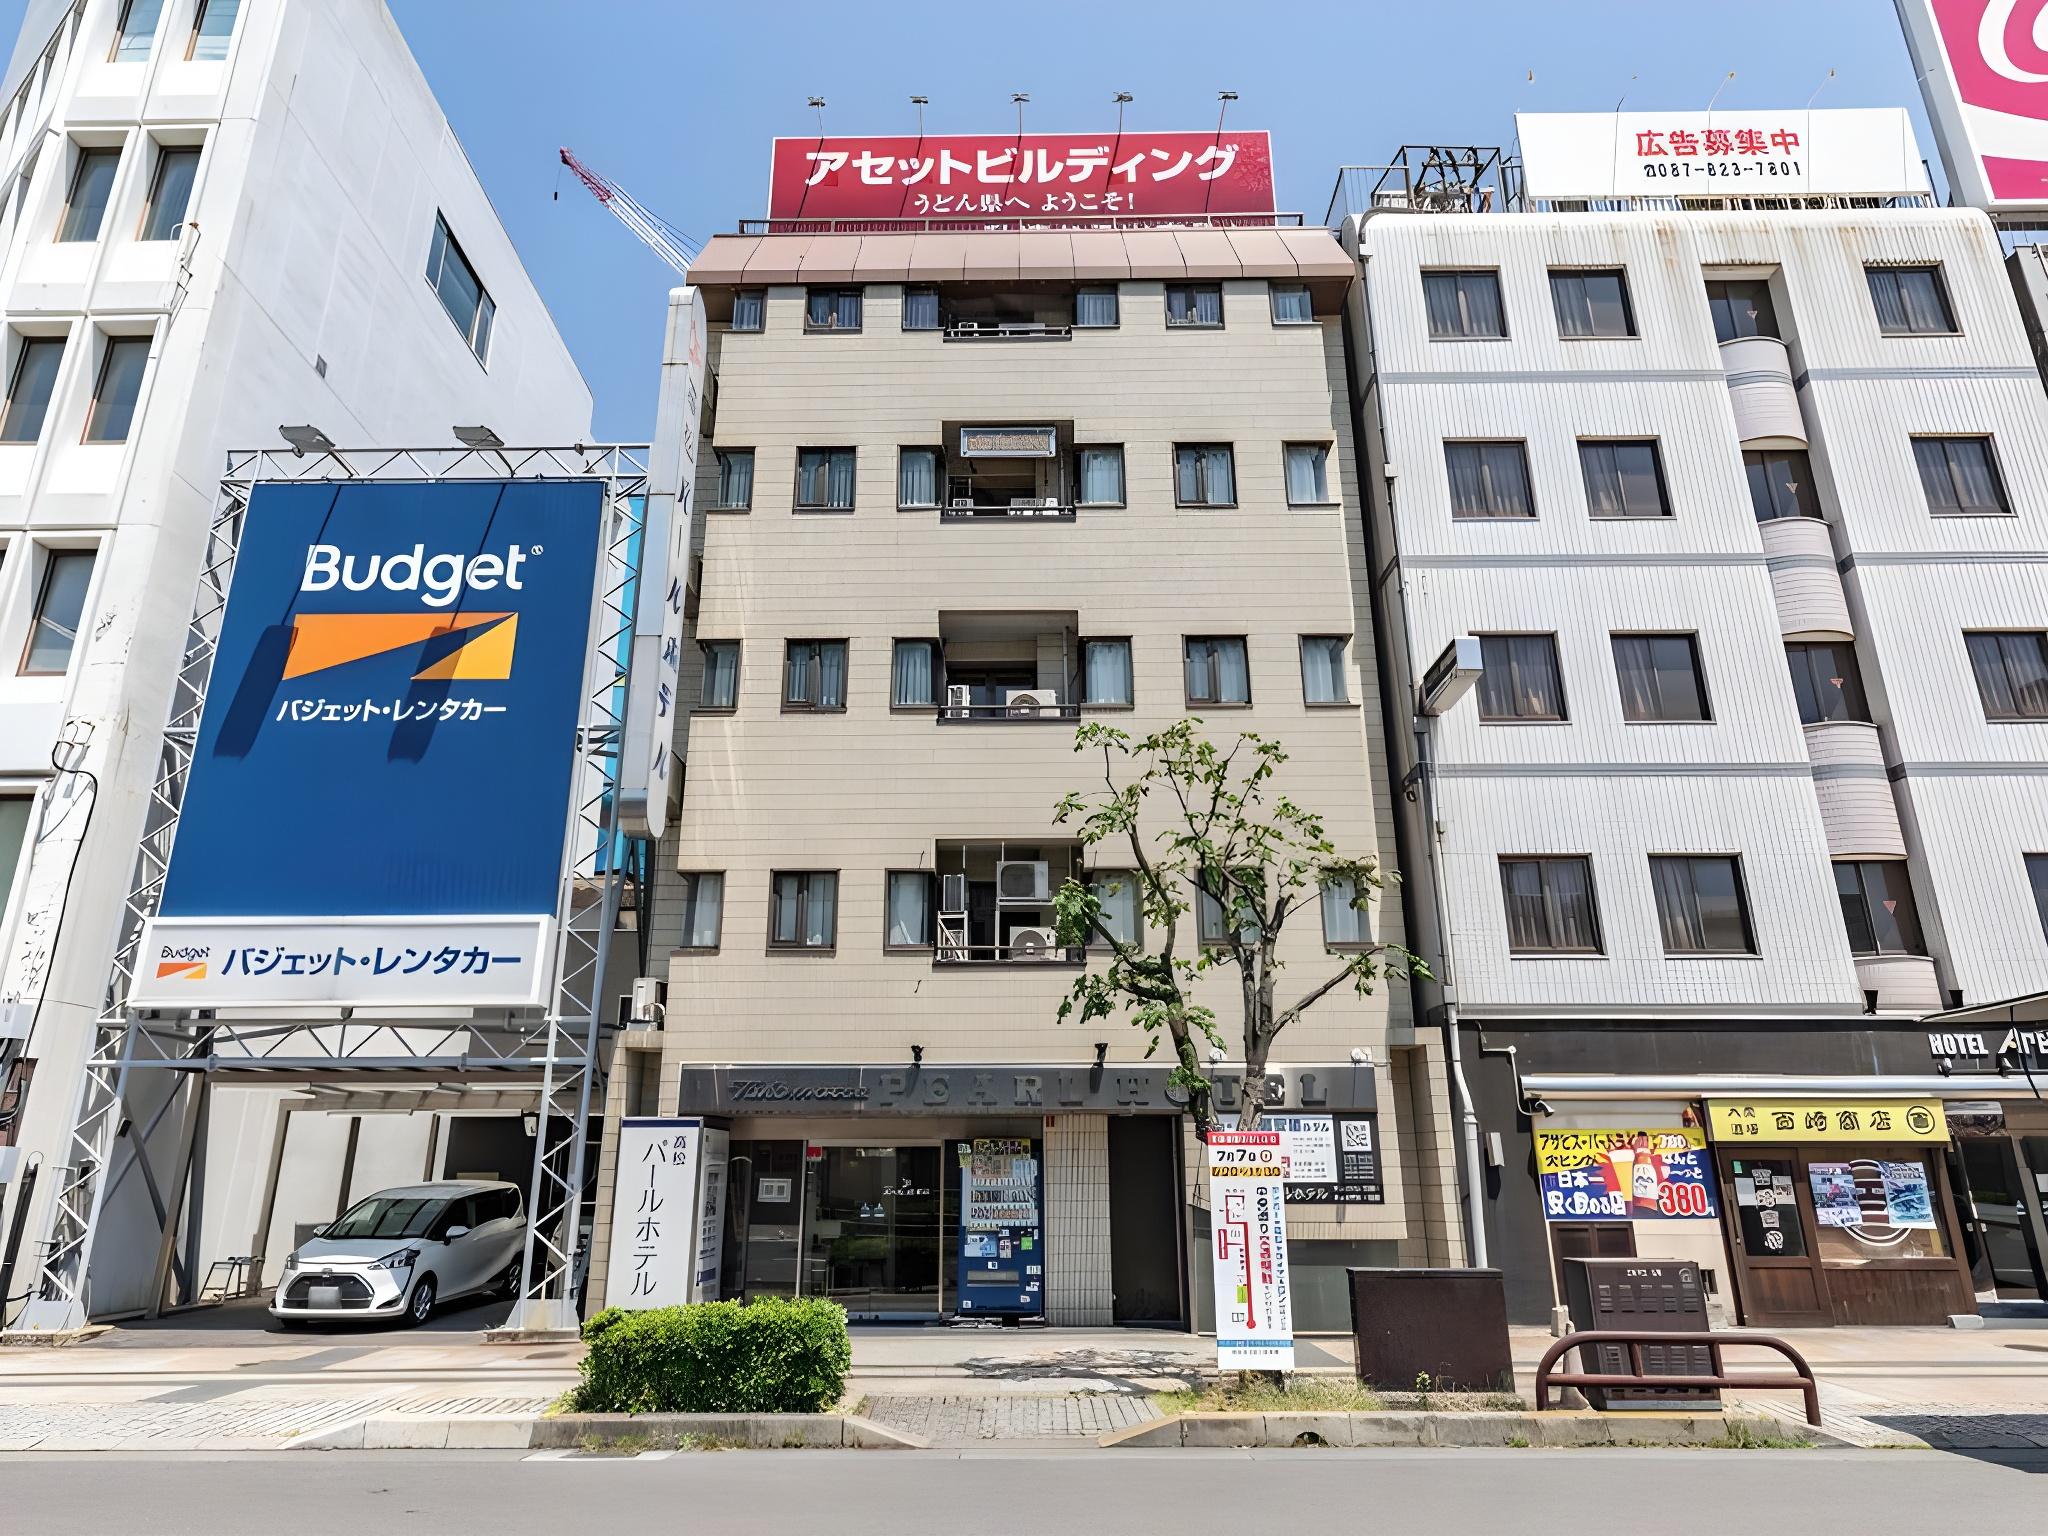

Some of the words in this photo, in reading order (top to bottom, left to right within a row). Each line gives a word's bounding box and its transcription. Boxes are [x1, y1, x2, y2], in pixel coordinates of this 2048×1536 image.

[1635, 128, 1800, 157] 広告募集中
[804, 143, 1239, 187] アセットビルディング
[913, 192, 1030, 214] うどん県へ
[299, 543, 527, 608] Budget
[275, 698, 507, 722] バジェット・レンタカー
[220, 945, 522, 976] バジェット・レンタカー
[1927, 1033, 1990, 1056] HOTEL
[1557, 1171, 1605, 1189] 日本一
[1658, 1182, 1708, 1216] 380
[630, 1139, 669, 1297] パールホテル
